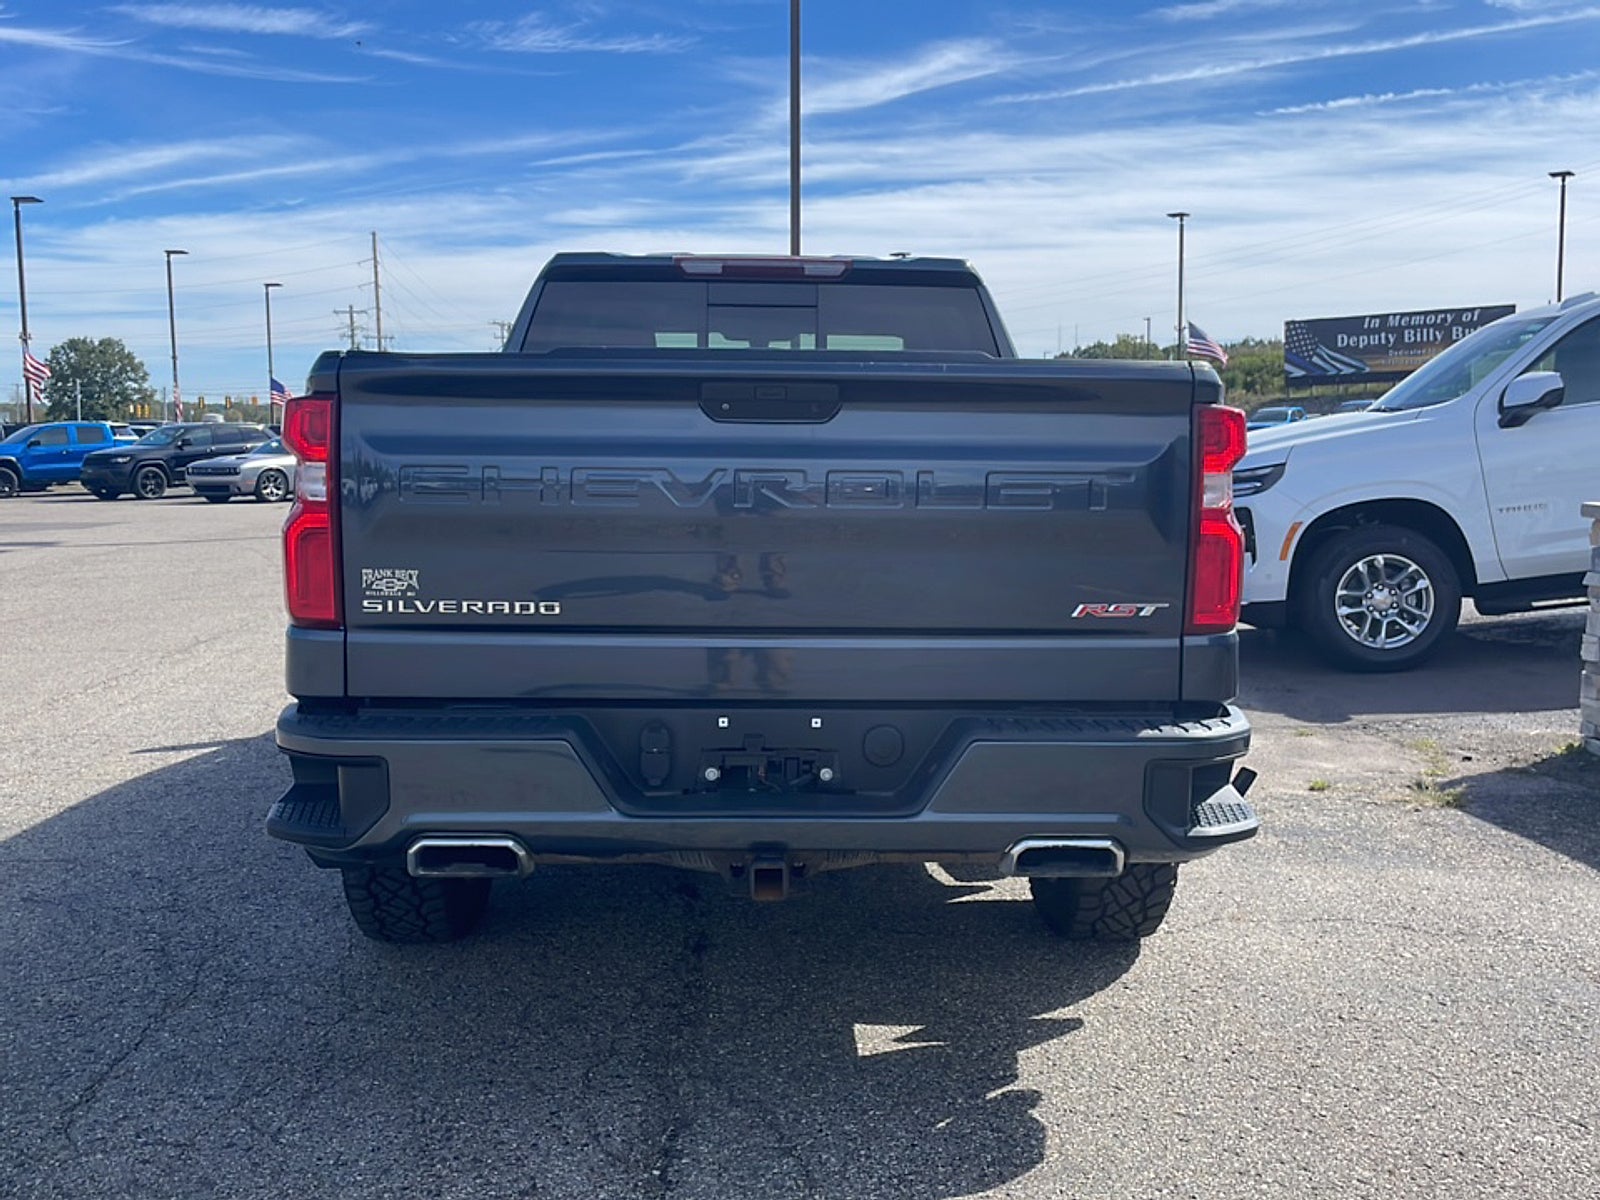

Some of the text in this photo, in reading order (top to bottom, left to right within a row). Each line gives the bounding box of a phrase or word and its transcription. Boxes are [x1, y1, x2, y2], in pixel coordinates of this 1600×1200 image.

[1363, 309, 1480, 329] In Memory of
[1337, 326, 1481, 348] Deputy Billy Bu
[399, 465, 1136, 511] CHEVROLET
[361, 568, 420, 590] FRANK BECK
[361, 599, 561, 615] SILVERADO
[1071, 603, 1170, 618] RST
